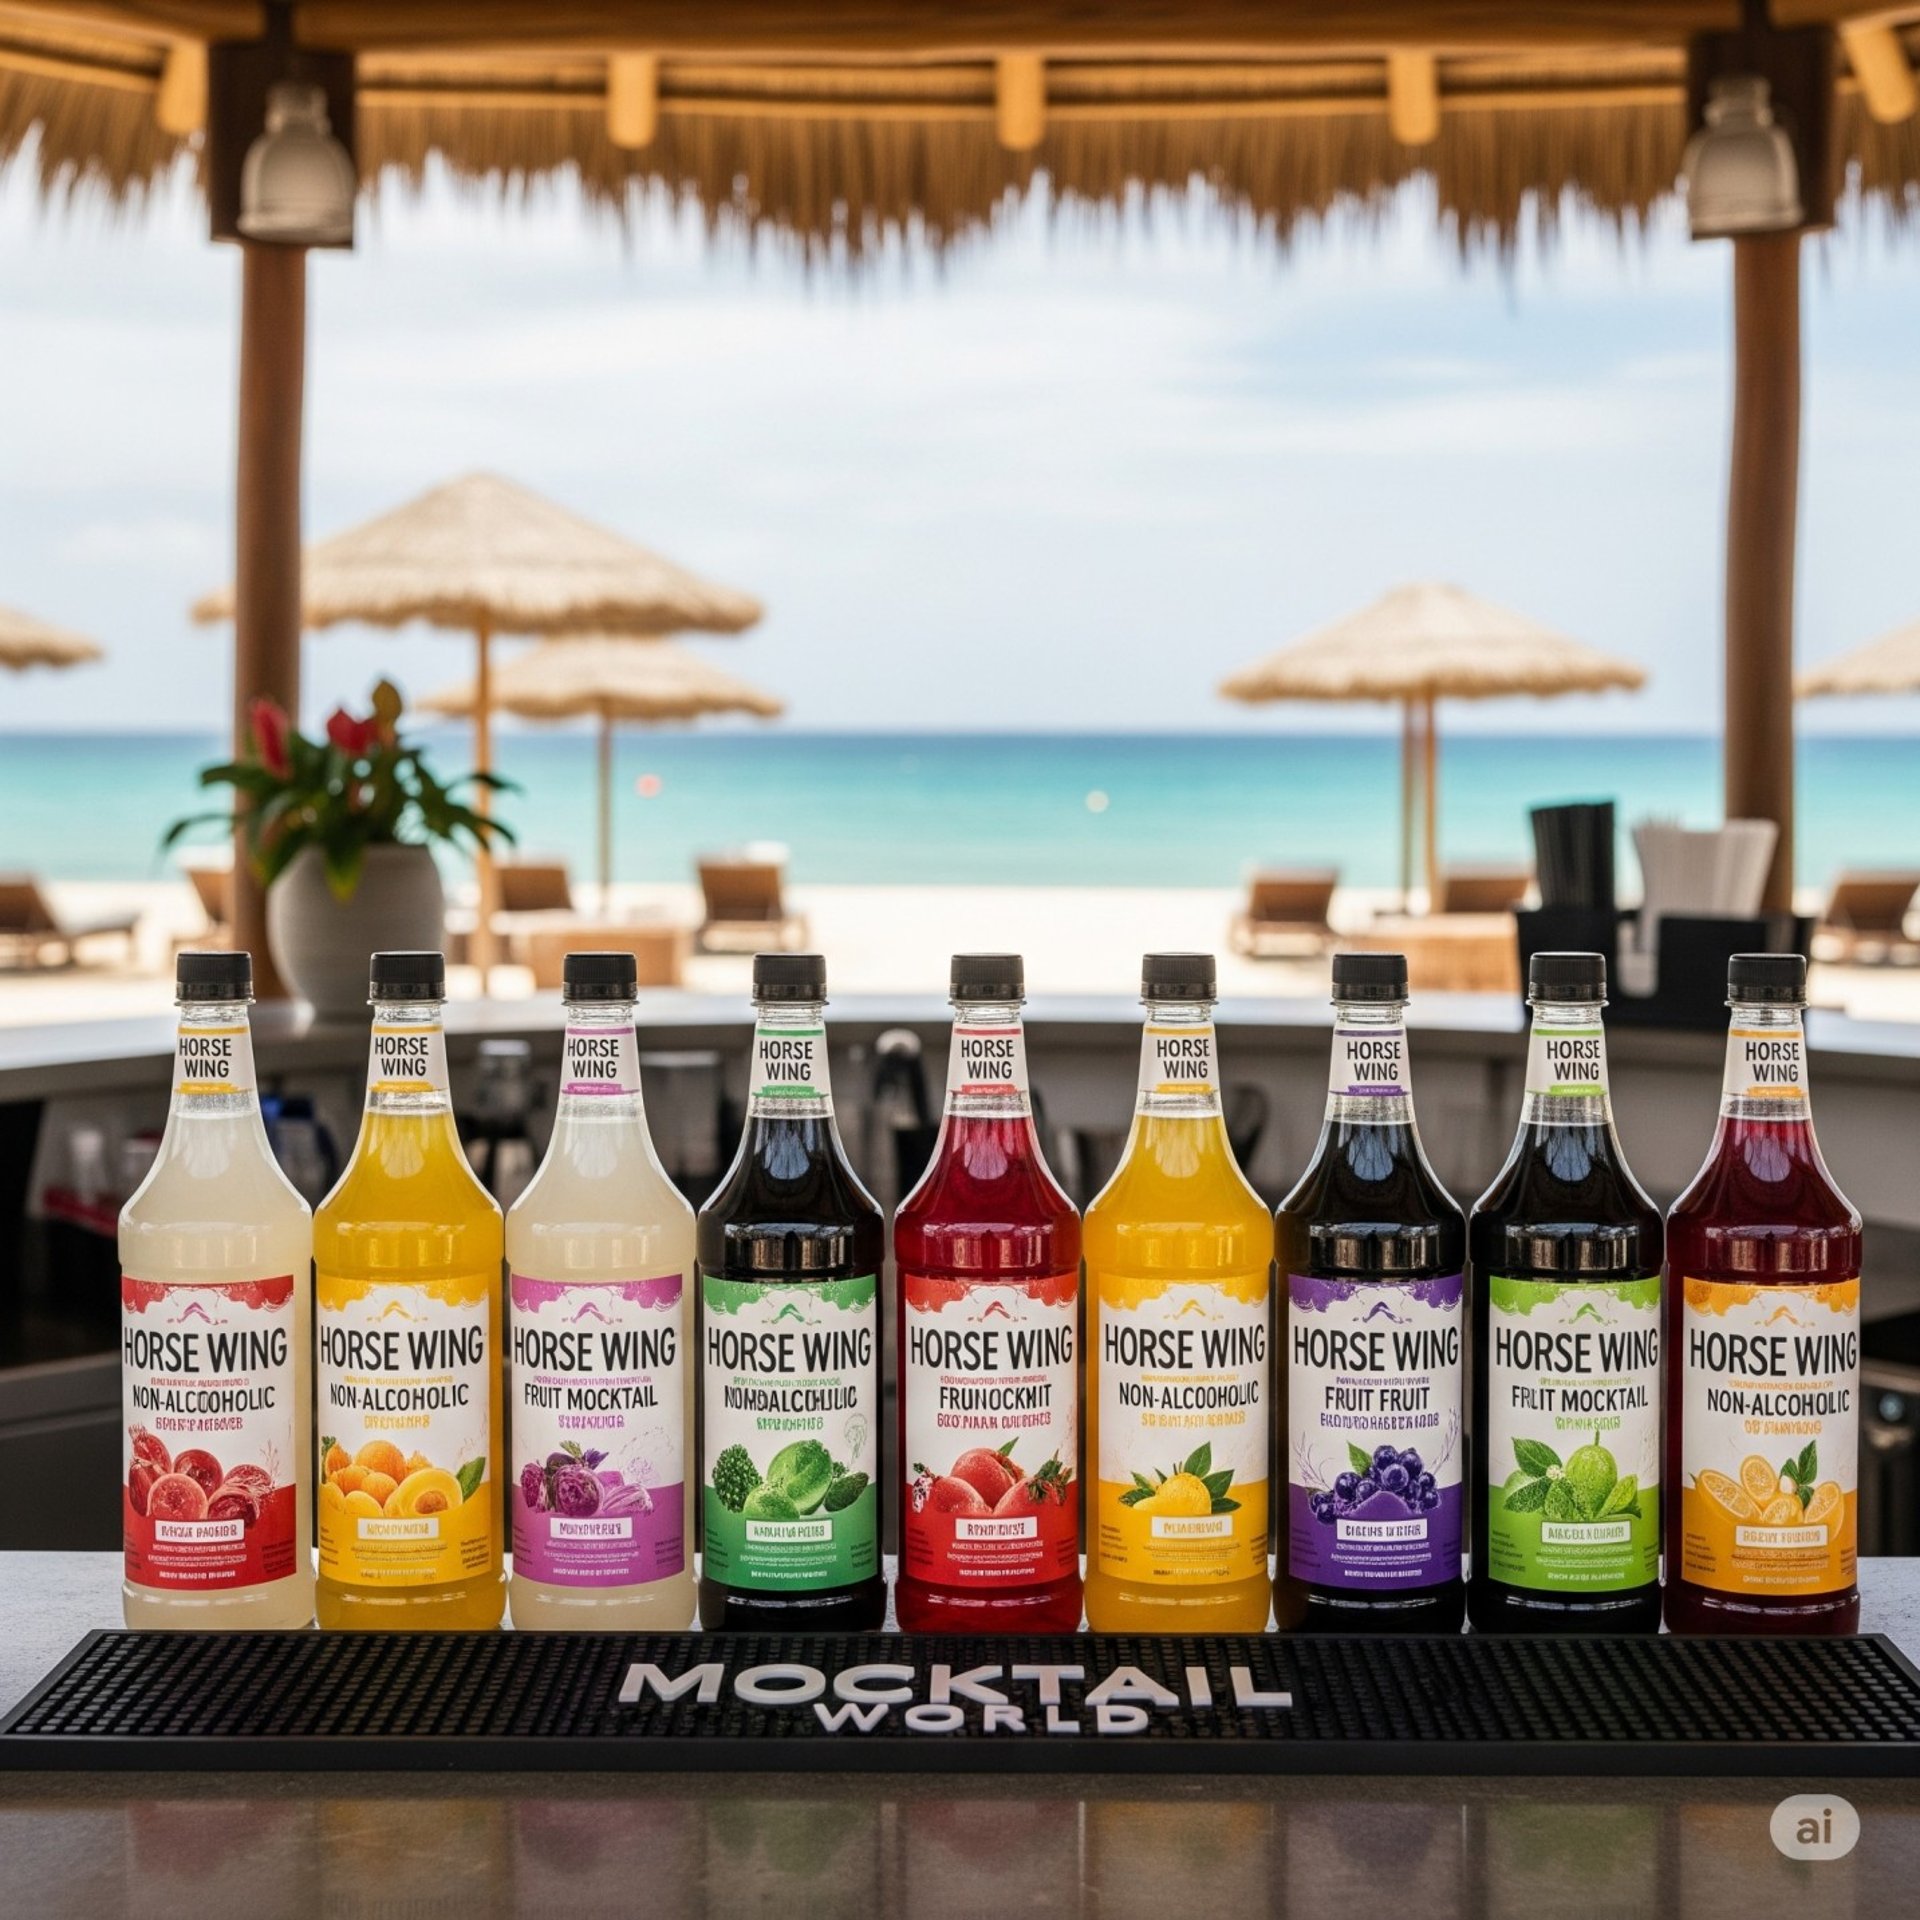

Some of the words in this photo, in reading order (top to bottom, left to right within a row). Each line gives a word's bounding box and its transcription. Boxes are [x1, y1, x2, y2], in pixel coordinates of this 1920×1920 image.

[179, 1038, 231, 1056] HORSE
[375, 1037, 428, 1055] HORSE
[568, 1039, 619, 1057] HORSE
[760, 1041, 812, 1059] HORSE
[962, 1040, 1014, 1057] HORSE
[1157, 1039, 1210, 1057] HORSE
[1348, 1041, 1400, 1059] HORSE
[1547, 1040, 1600, 1059] HORSE
[1746, 1042, 1799, 1061] HORSE
[185, 1060, 229, 1077] WING
[381, 1059, 426, 1076] WING
[573, 1061, 616, 1078] WING
[766, 1062, 811, 1080] WING
[968, 1061, 1012, 1078] WING
[1164, 1061, 1208, 1078] WING
[1355, 1063, 1398, 1080] WING
[1555, 1062, 1599, 1080] WING
[1753, 1064, 1798, 1082] WING
[124, 1327, 199, 1373] HORSE
[208, 1327, 287, 1373] WING
[321, 1325, 399, 1370] HORSE
[408, 1326, 483, 1370] WING
[514, 1326, 593, 1371] HORSE
[601, 1327, 675, 1371] WING
[708, 1327, 795, 1373] HORSE
[803, 1327, 870, 1373] WING
[911, 1326, 998, 1370] HORSE
[1007, 1326, 1072, 1370] WING
[1105, 1324, 1193, 1368] HORSE
[1202, 1324, 1265, 1368] WING
[1294, 1326, 1384, 1371] HORSE
[1393, 1327, 1458, 1372] WING
[1496, 1327, 1591, 1373] HORSE
[1599, 1329, 1657, 1373] WING
[1690, 1328, 1786, 1376] HORSE
[1794, 1330, 1856, 1376] WING
[525, 1383, 562, 1409] FRUIT
[568, 1387, 658, 1411] MOCKTAIL
[1325, 1387, 1374, 1411] FRUIT
[1380, 1387, 1430, 1411] FRUIT
[1561, 1387, 1648, 1412] MOCKTAIL
[618, 1663, 1293, 1707] MOCKTAIL
[813, 1703, 1149, 1734] WORLD
